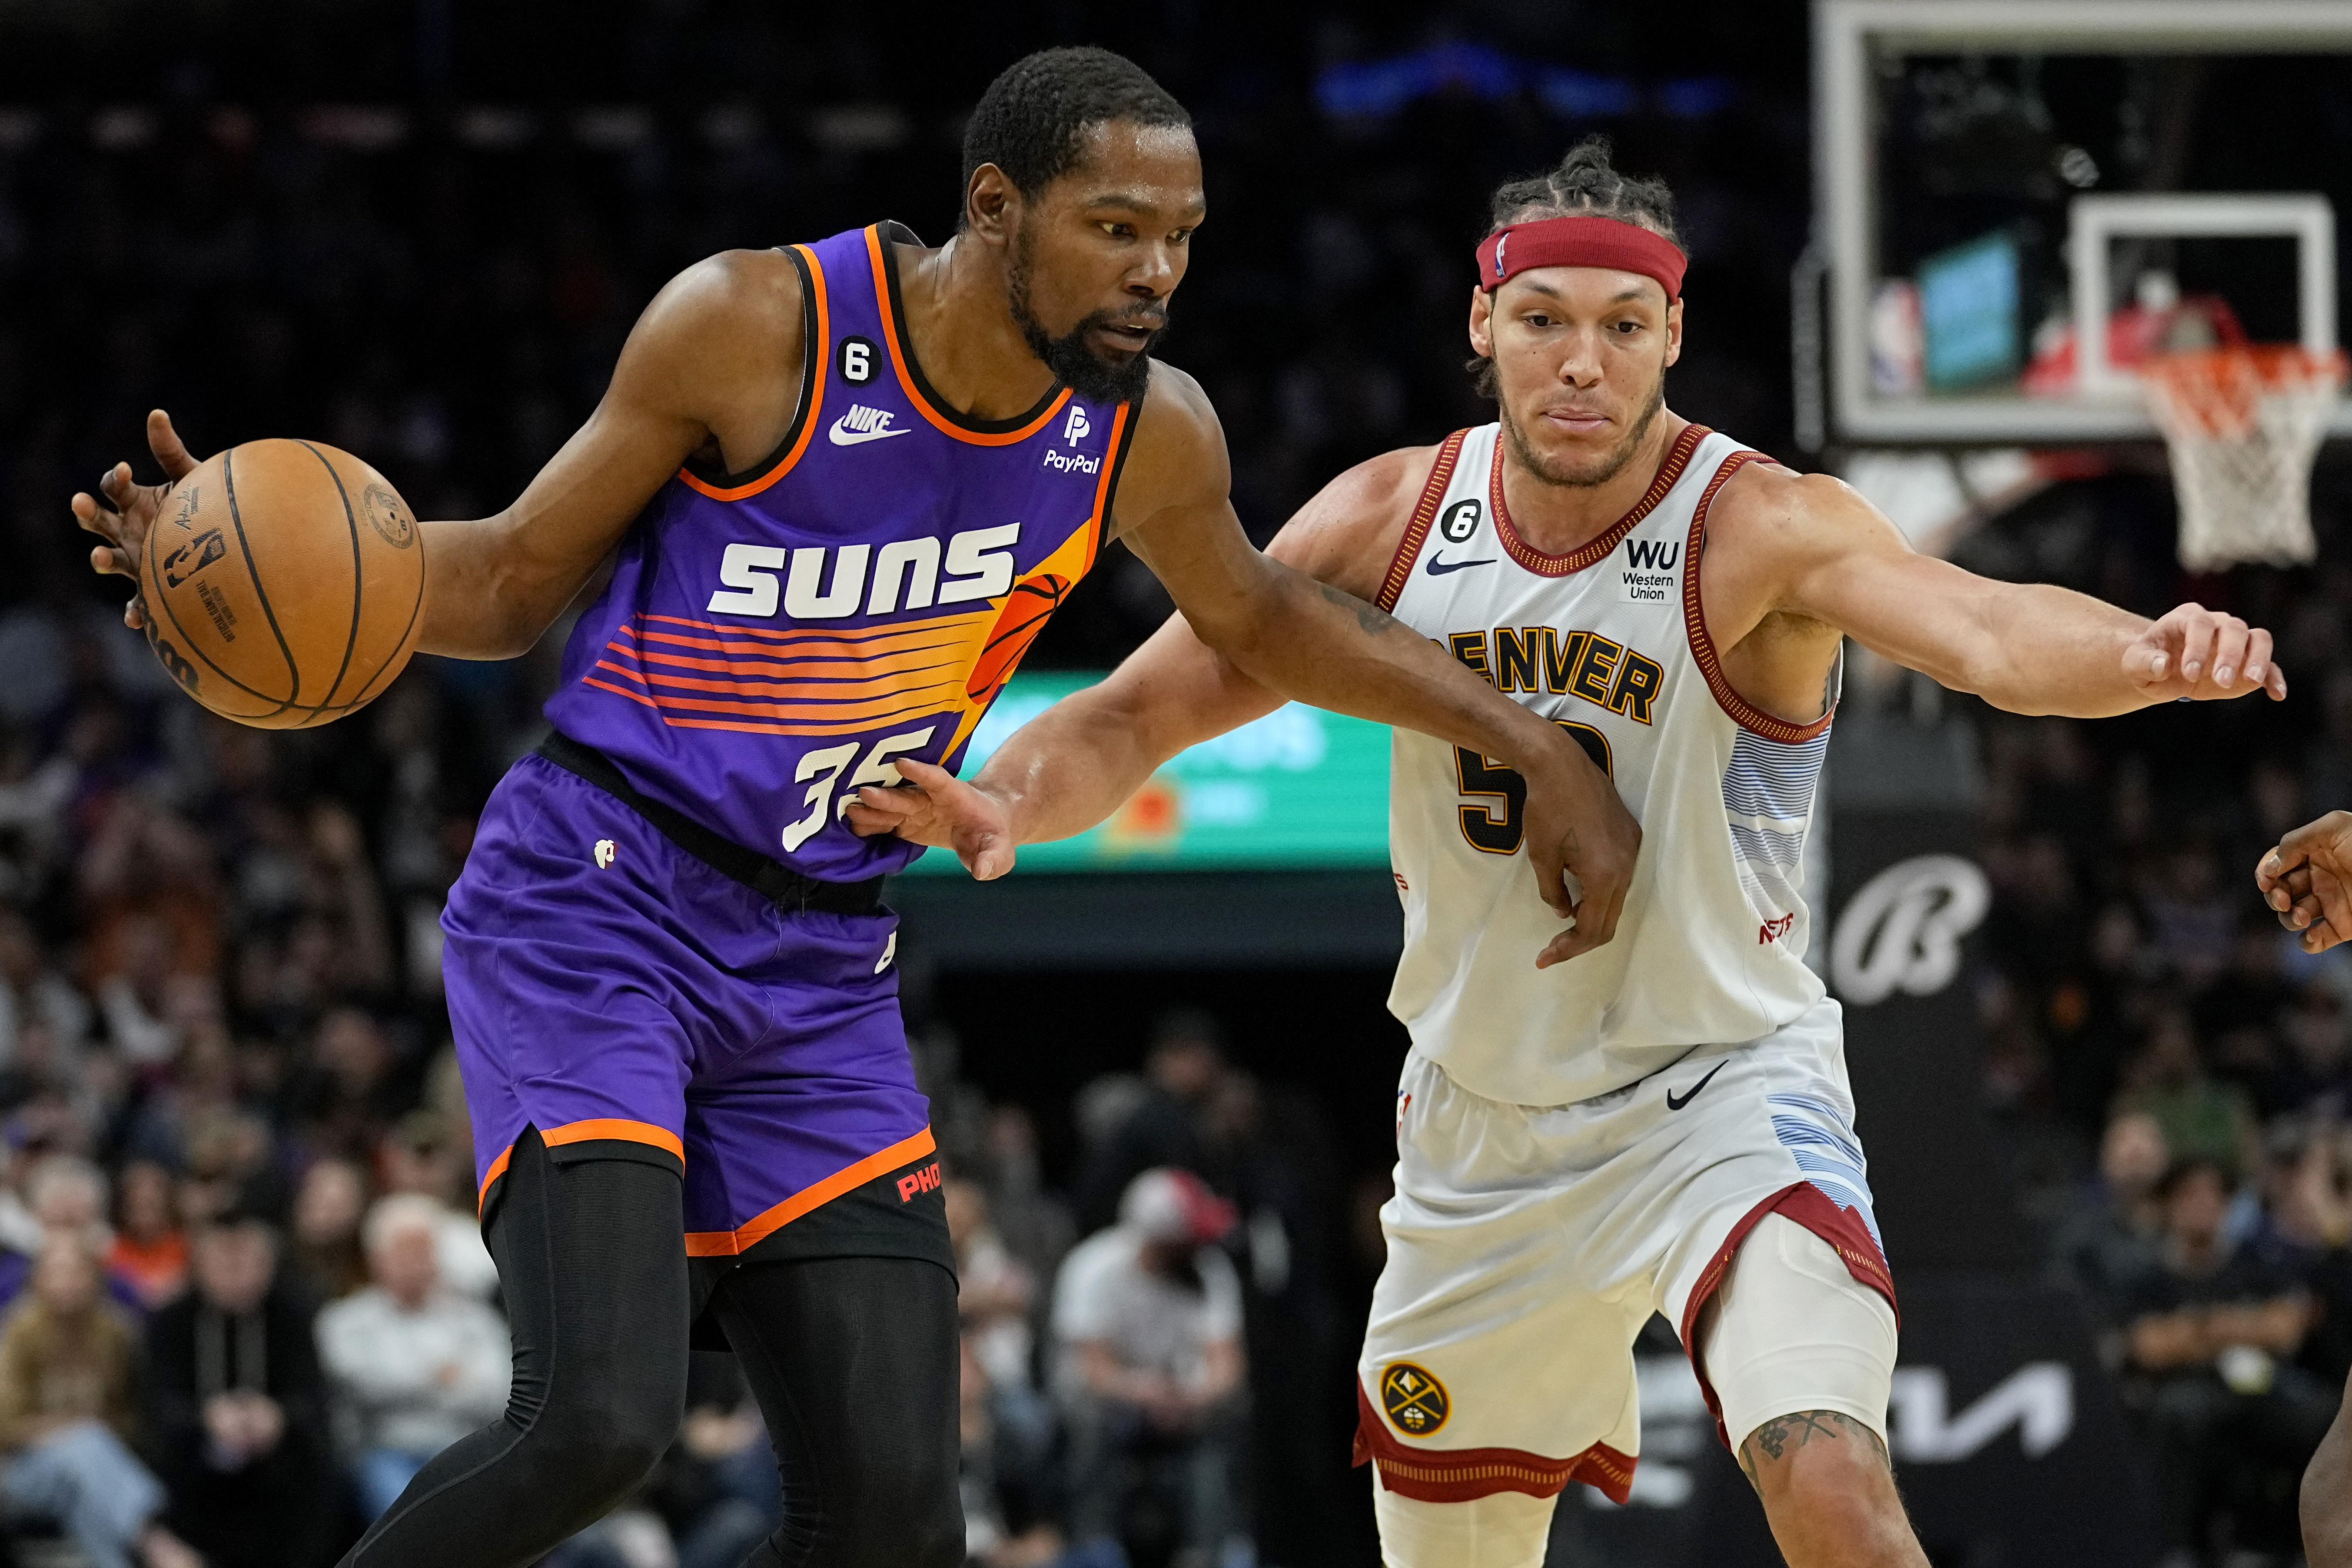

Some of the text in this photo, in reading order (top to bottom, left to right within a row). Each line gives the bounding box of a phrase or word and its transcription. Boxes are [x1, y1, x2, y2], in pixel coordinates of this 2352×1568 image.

[845, 342, 870, 381] 6
[842, 404, 894, 433] NIKE
[1043, 449, 1100, 474] PayPal
[1449, 505, 1477, 538] 6
[706, 522, 1020, 618] SUNS
[1627, 539, 1679, 570] WU
[1623, 572, 1673, 586] Western
[1631, 587, 1664, 600] Union
[196, 580, 235, 642] OFFICIAL GAME BALL
[1430, 626, 1664, 726] ENVER
[782, 725, 936, 852] 35
